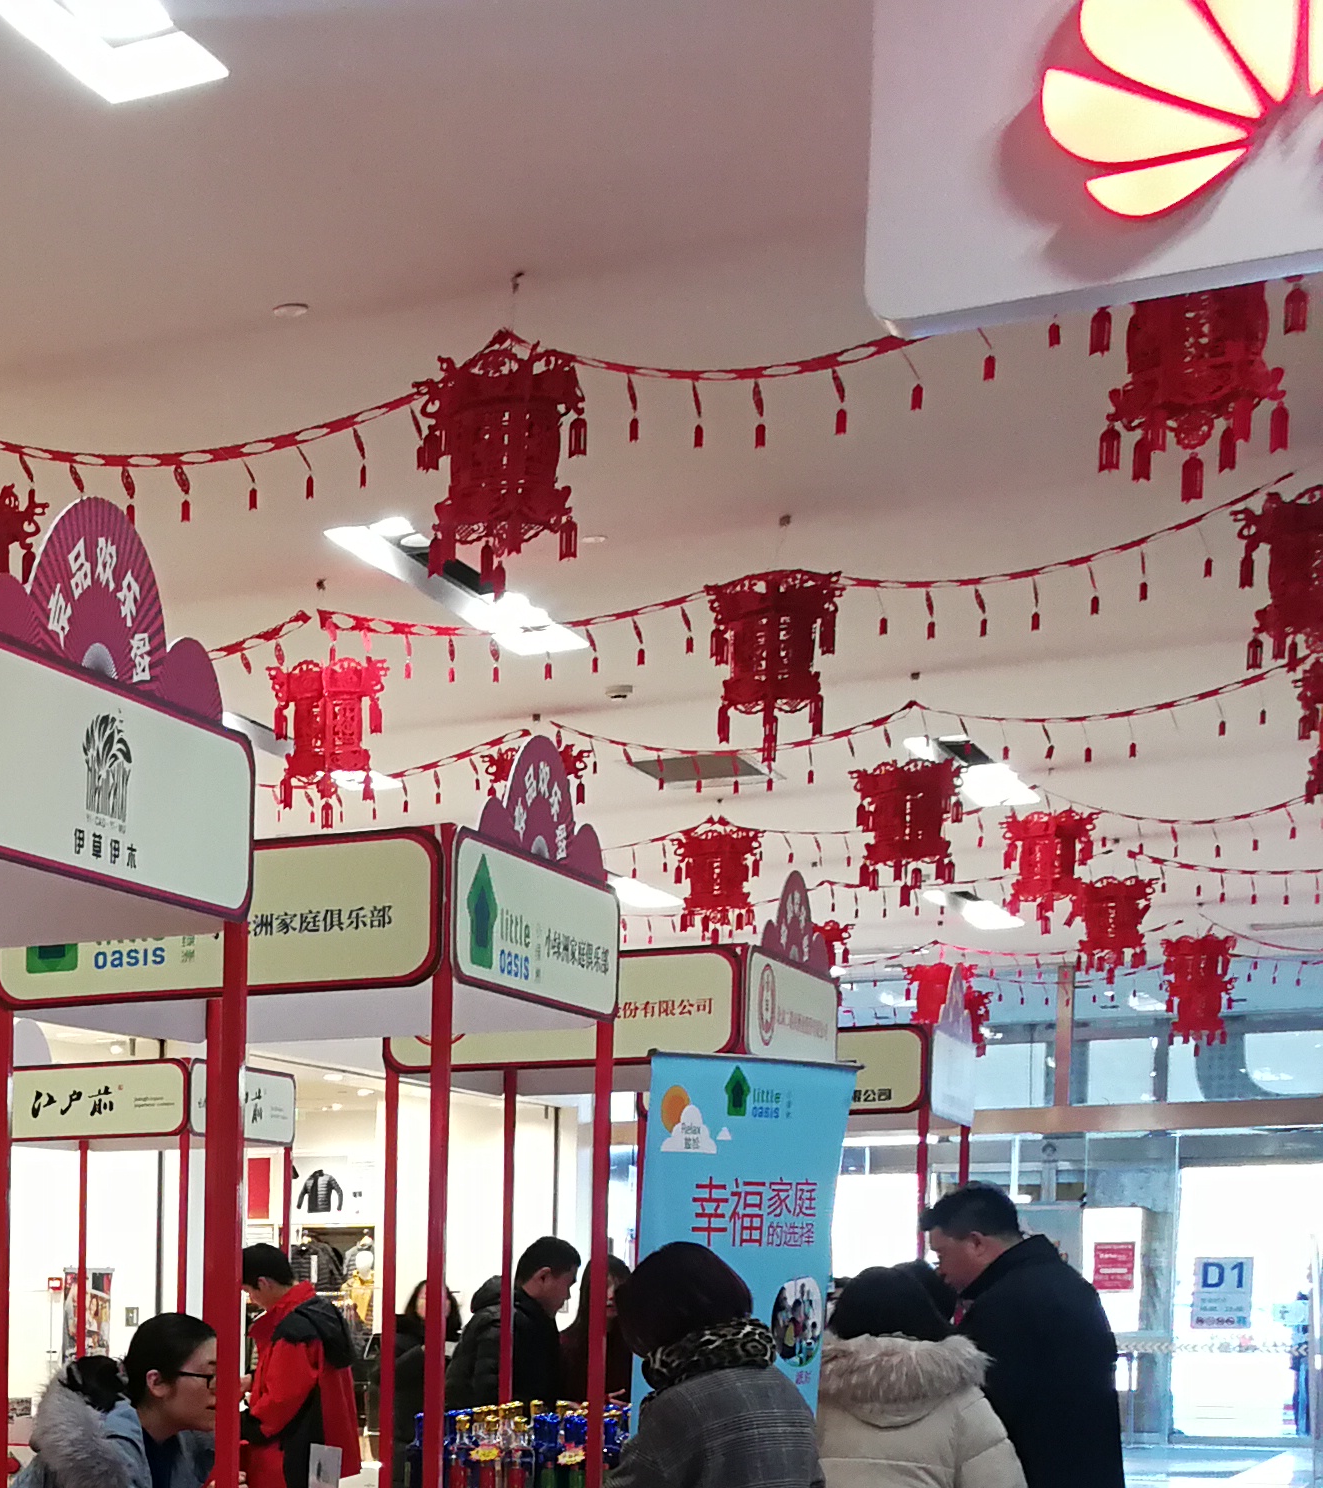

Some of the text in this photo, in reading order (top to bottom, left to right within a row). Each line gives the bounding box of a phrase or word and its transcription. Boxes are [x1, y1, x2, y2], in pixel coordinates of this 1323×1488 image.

[46, 536, 153, 684] 京品欢乐购
[73, 827, 138, 869] 伊草伊木
[213, 904, 393, 941] 洲家庭俱乐部
[498, 906, 532, 950] little
[92, 945, 167, 971] oasis
[498, 948, 531, 981] oasis
[751, 1105, 781, 1119] oasis
[752, 1087, 782, 1105] little
[691, 1175, 767, 1248] 幸福
[767, 1176, 819, 1218] 家庭
[766, 1221, 816, 1249] 的选择
[1201, 1260, 1247, 1290] D1
